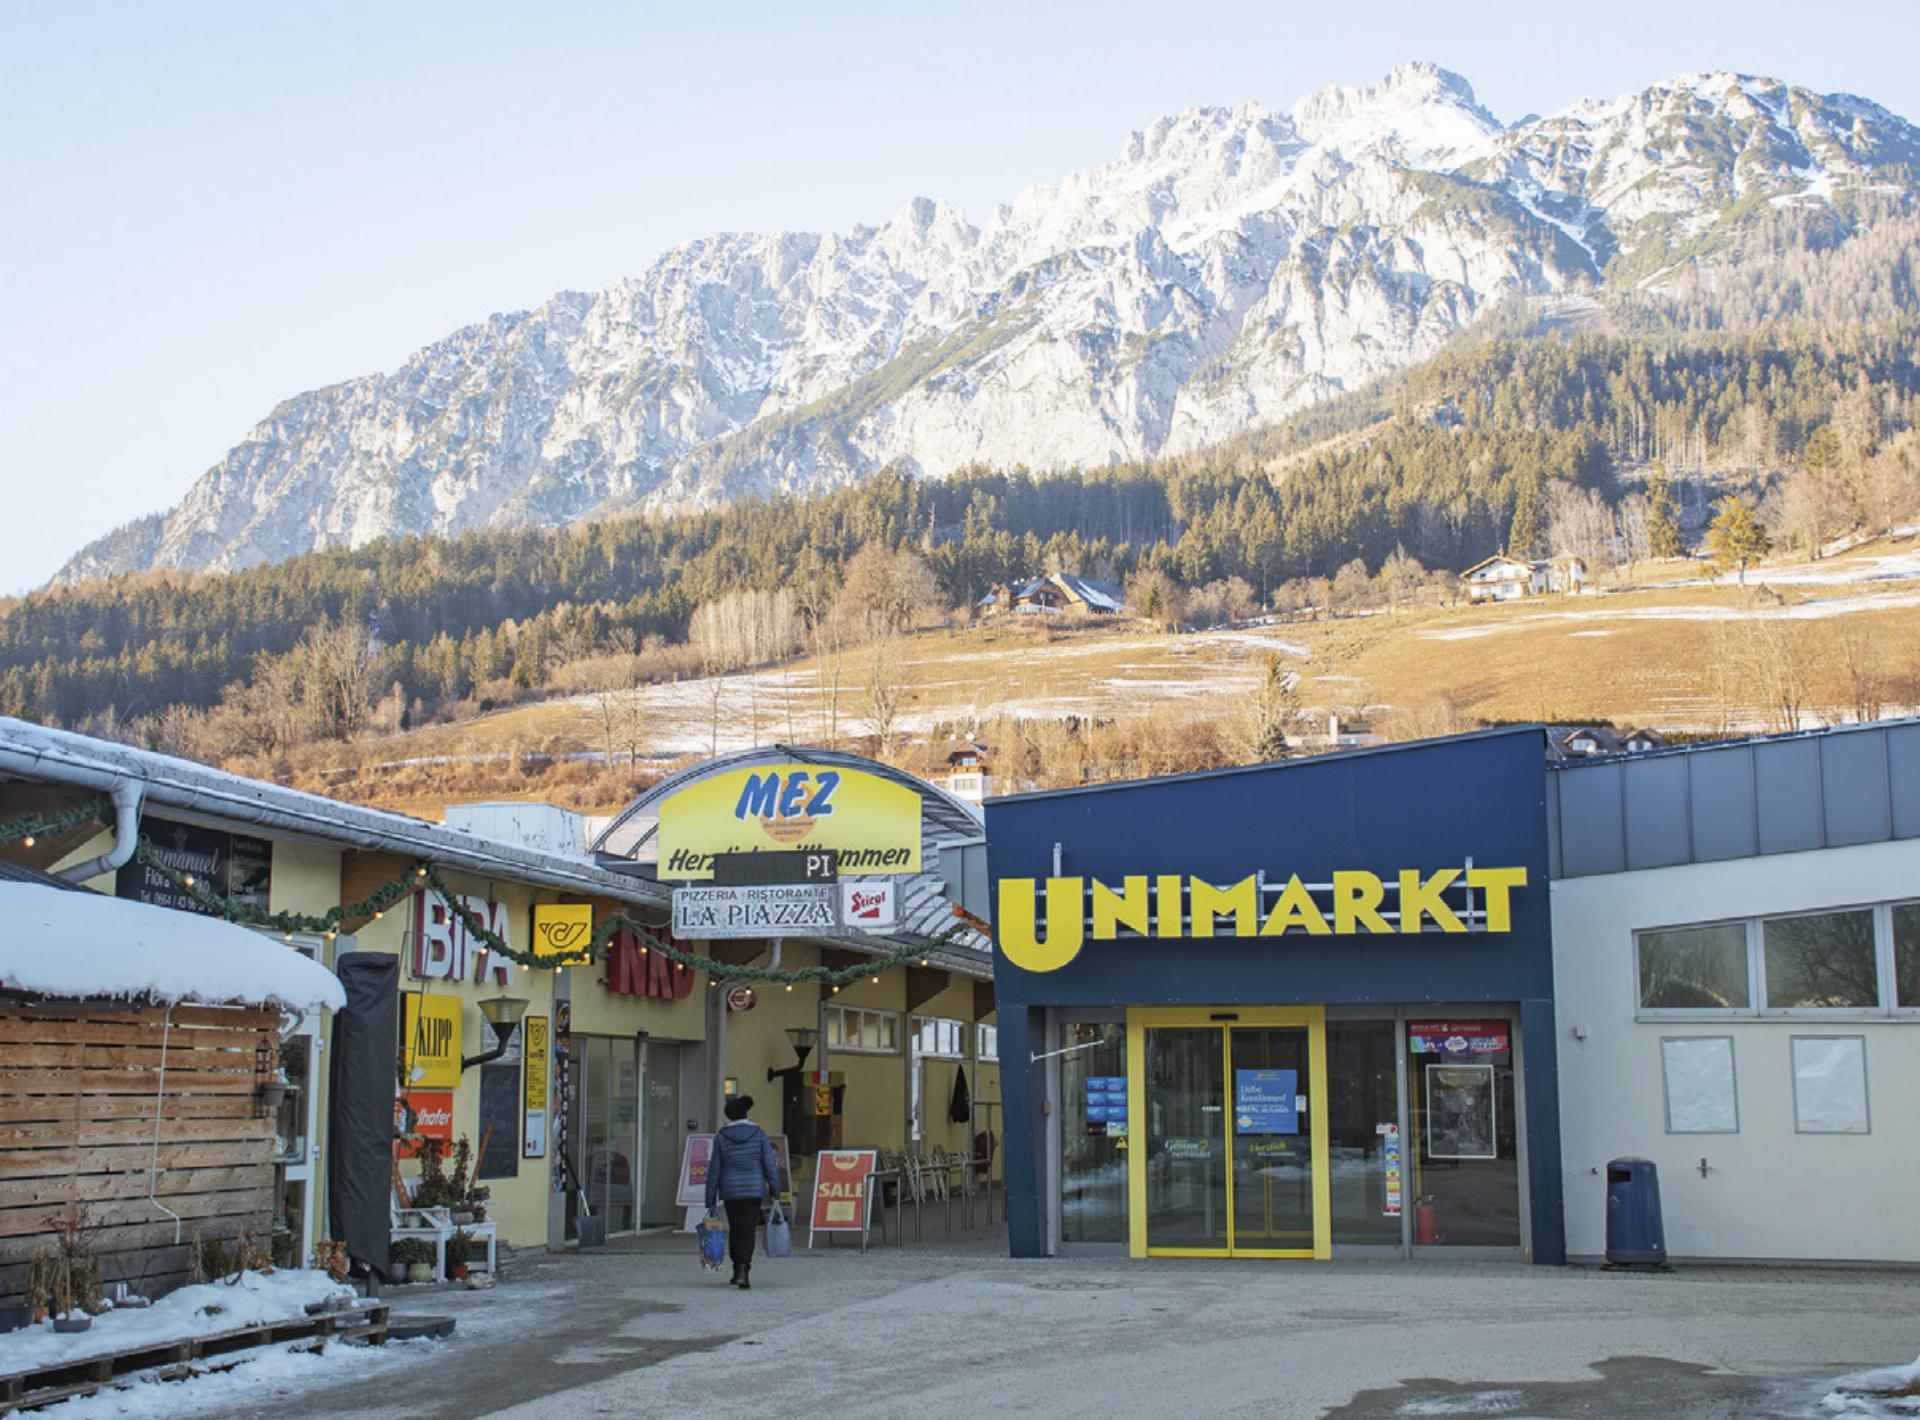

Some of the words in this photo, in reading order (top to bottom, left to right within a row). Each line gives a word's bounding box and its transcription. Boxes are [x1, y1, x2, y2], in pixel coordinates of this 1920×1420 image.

[735, 771, 840, 820] MEZ
[681, 890, 738, 901] PIZZERIA
[682, 905, 717, 926] LA
[727, 903, 832, 925] PIAZZA
[417, 888, 514, 985] BIPA
[999, 866, 1527, 972] UNIMARKT
[417, 1016, 452, 1058] KLIPP
[818, 1182, 864, 1198] SALE
